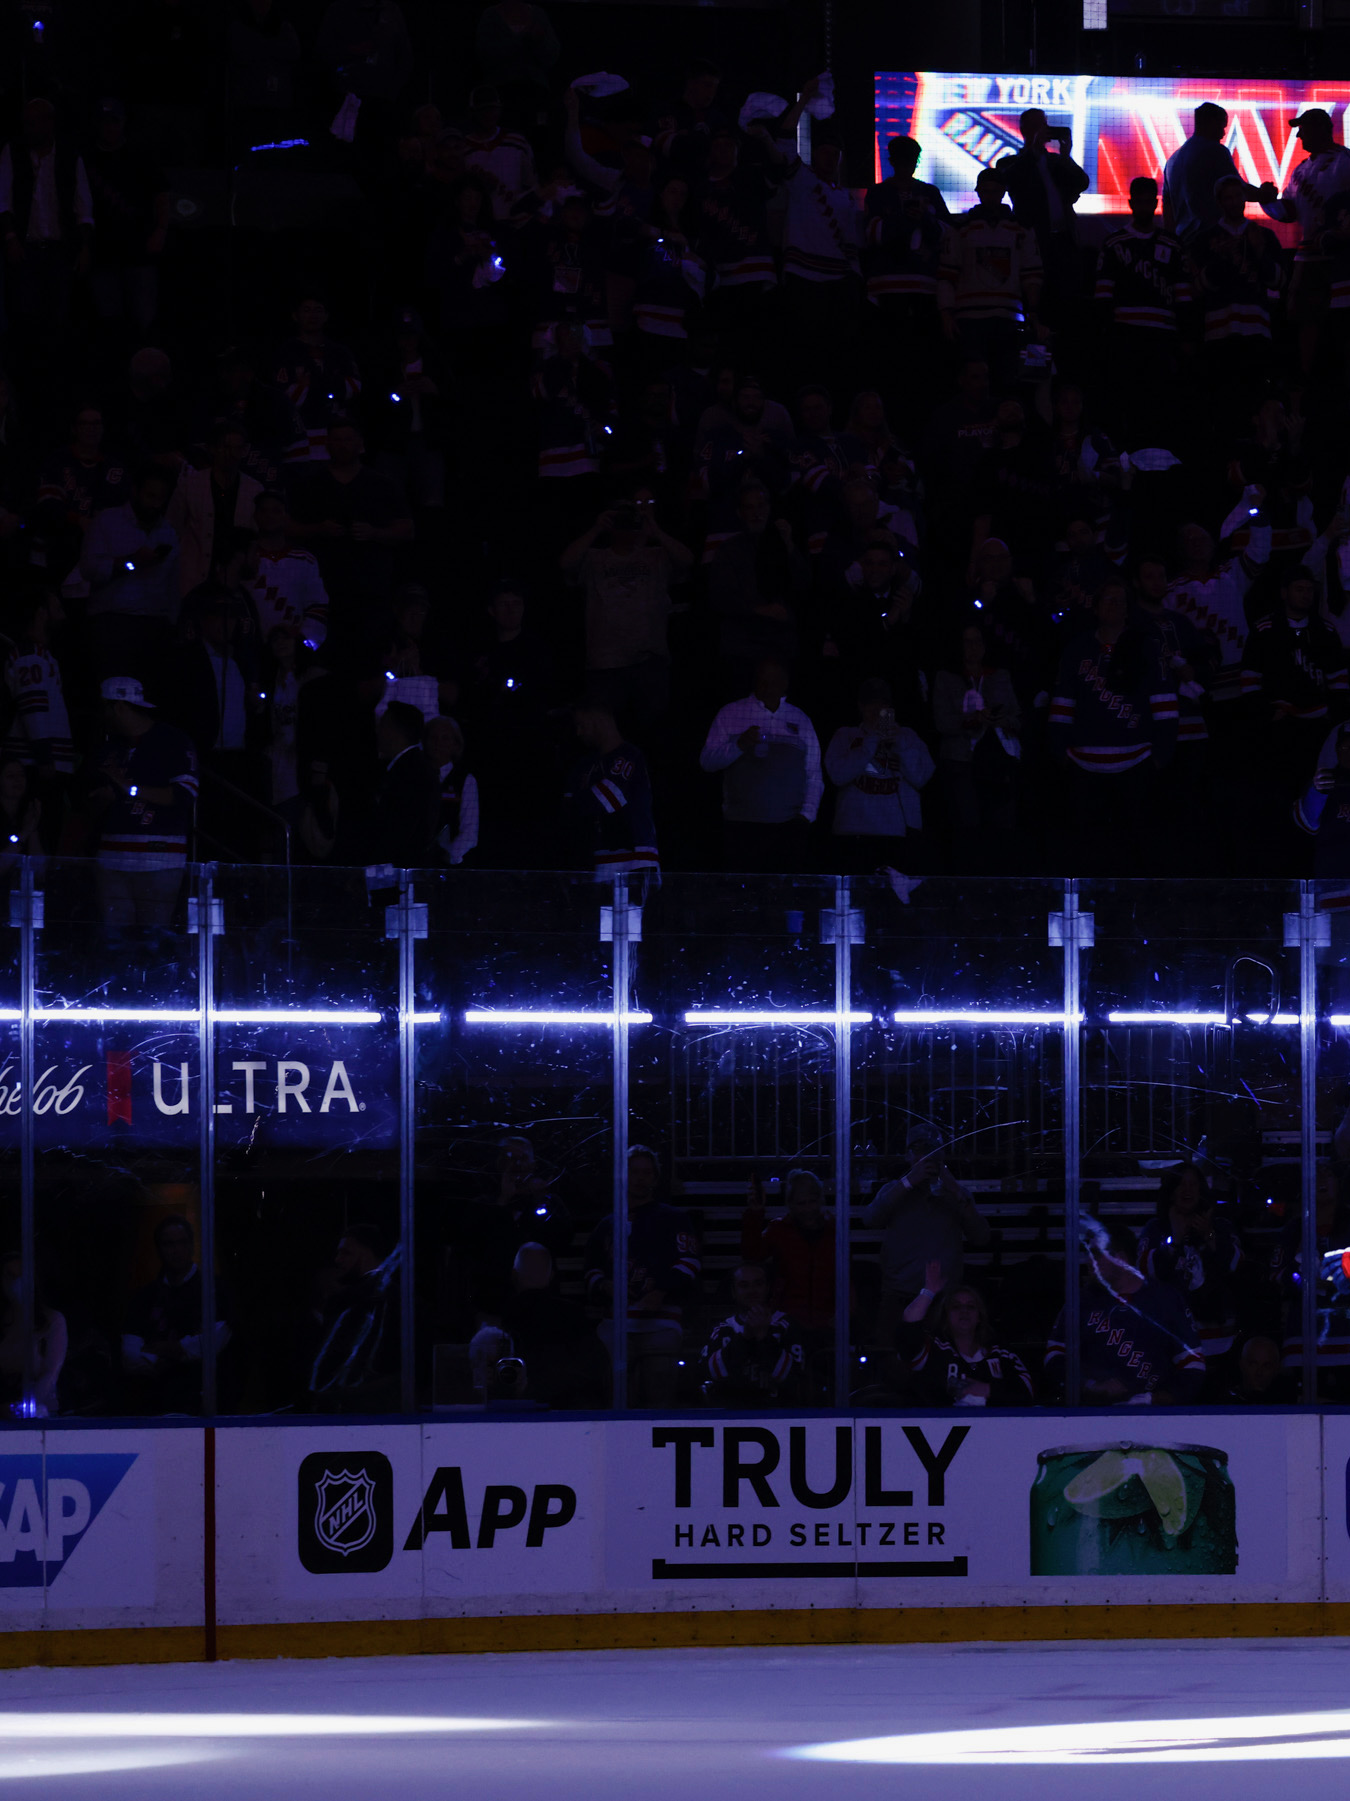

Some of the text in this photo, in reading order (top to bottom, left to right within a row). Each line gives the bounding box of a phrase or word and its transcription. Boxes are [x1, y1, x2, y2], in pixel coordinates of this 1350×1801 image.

[995, 78, 1071, 104] YORK
[1078, 658, 1142, 729] RANGERS
[152, 1060, 360, 1116] UTRA
[1087, 1311, 1160, 1391] RANGERS
[653, 1426, 970, 1510] TRULY
[328, 1487, 367, 1536] NHL
[675, 1522, 946, 1548] HARD SELTZER
